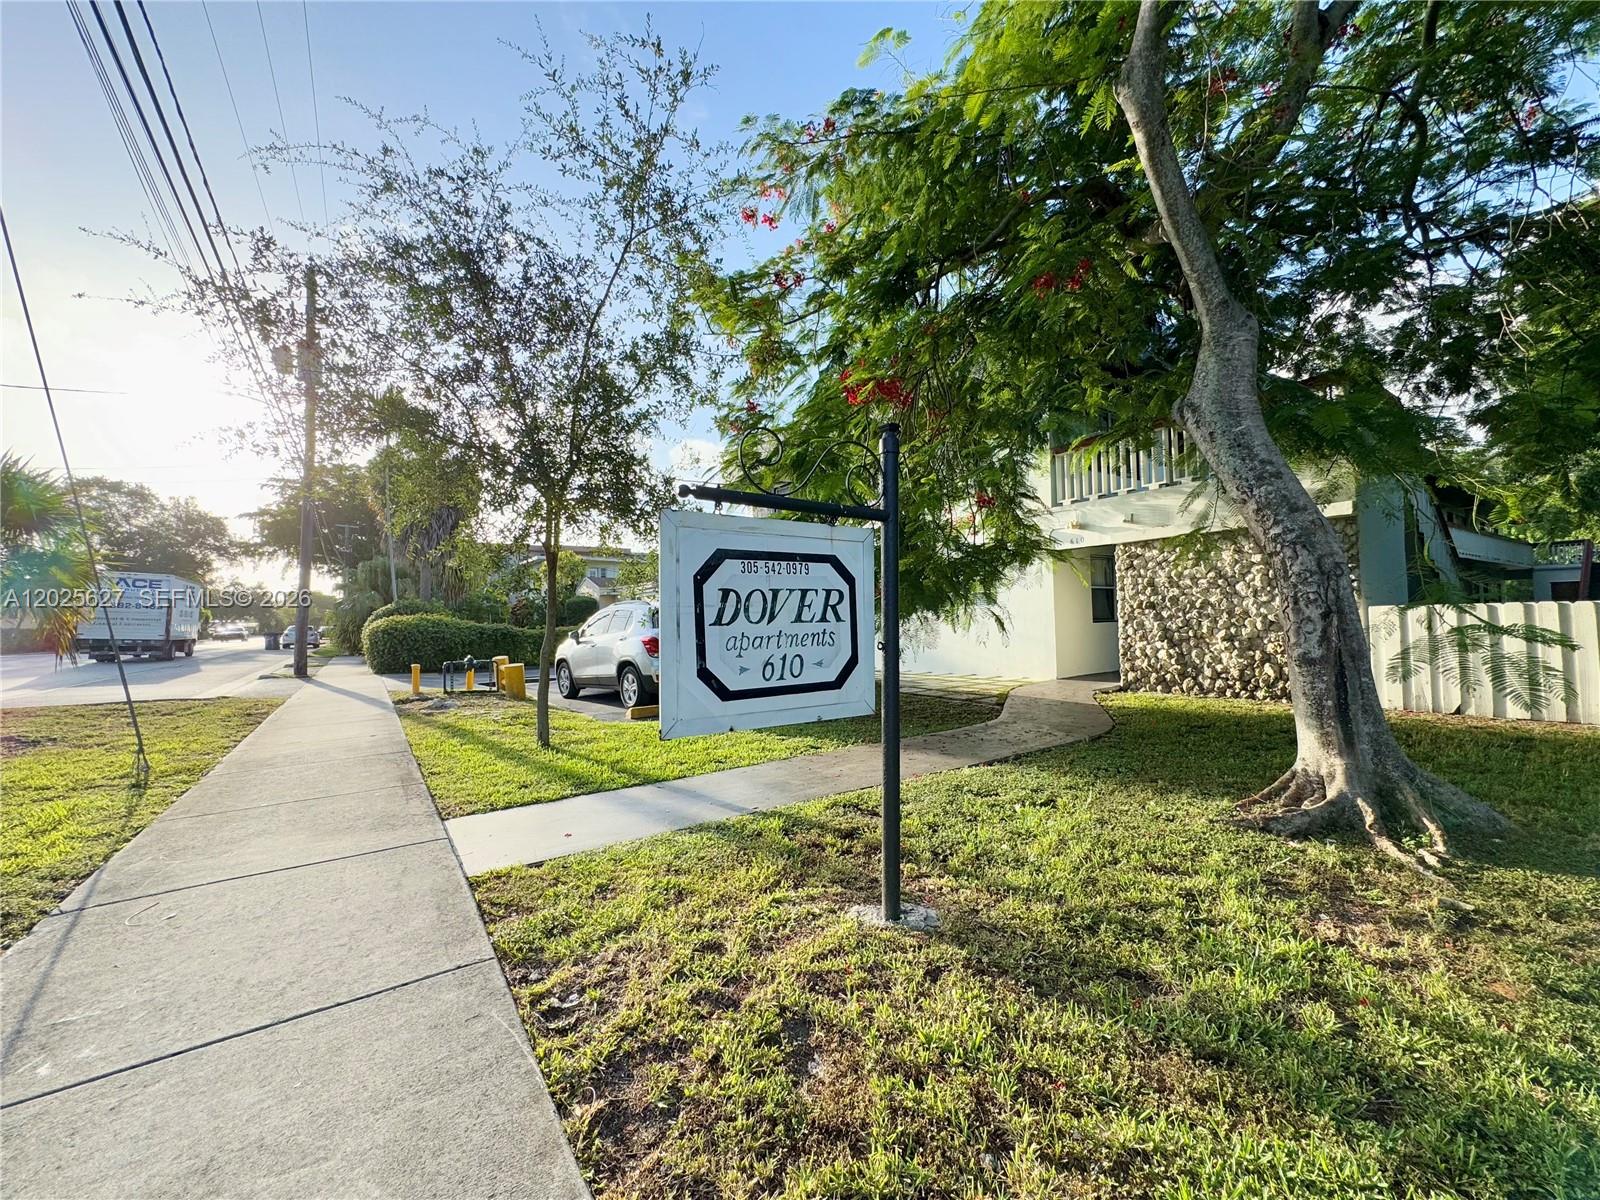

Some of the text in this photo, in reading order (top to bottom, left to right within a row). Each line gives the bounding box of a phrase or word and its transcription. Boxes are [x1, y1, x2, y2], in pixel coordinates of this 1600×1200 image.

[116, 577, 162, 589] ACE
[740, 561, 810, 576] 305-542-0979
[708, 587, 846, 627] DOVER
[725, 628, 836, 658] apartments
[761, 653, 804, 682] 610
